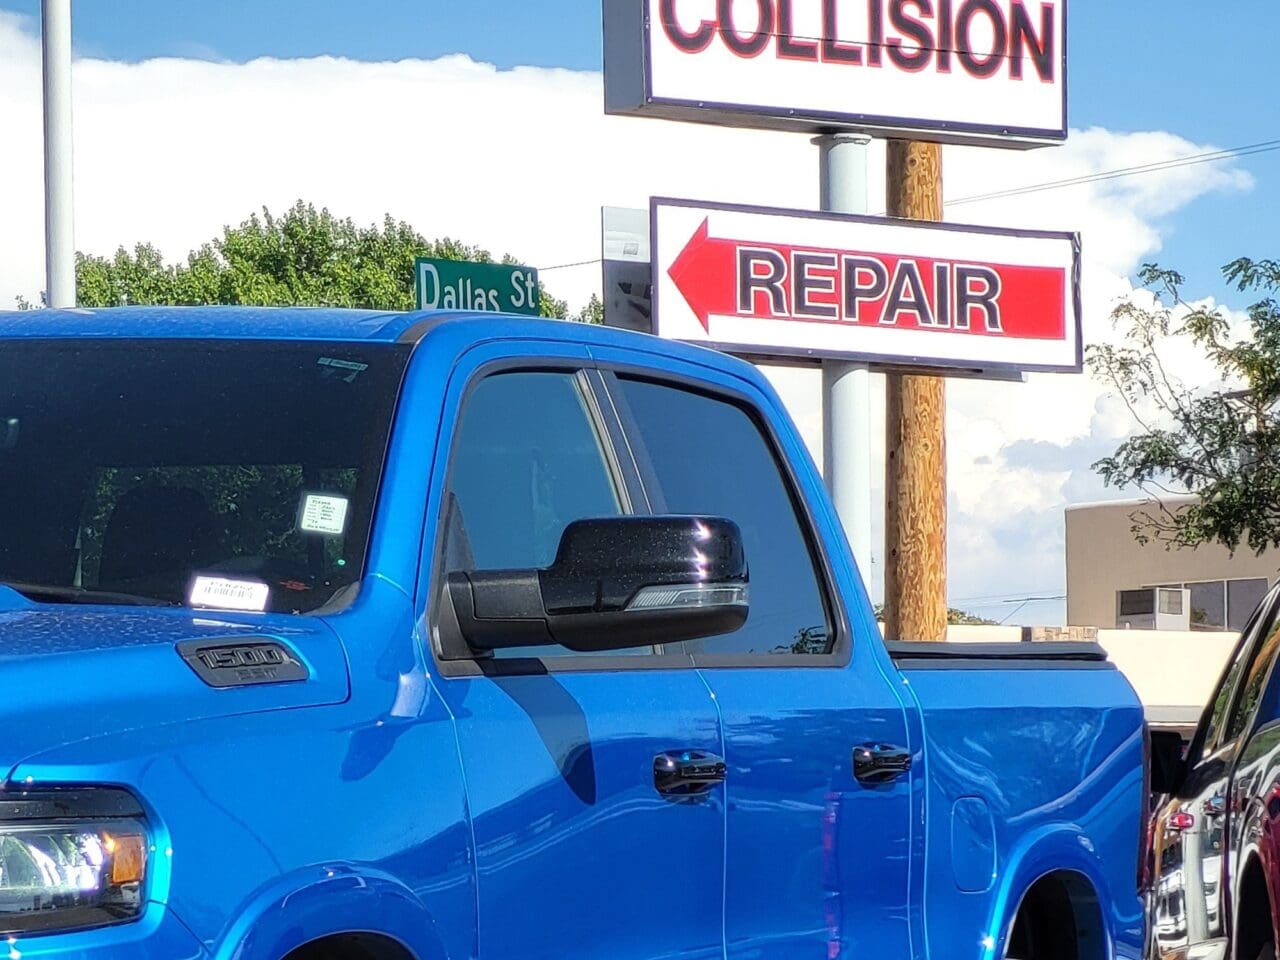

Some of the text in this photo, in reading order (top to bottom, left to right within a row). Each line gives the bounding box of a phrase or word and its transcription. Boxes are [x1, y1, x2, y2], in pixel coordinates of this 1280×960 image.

[659, 0, 1055, 83] COLLISION
[420, 262, 536, 312] Dallas St
[735, 244, 1004, 334] REPAIR
[199, 647, 281, 669] 1500
